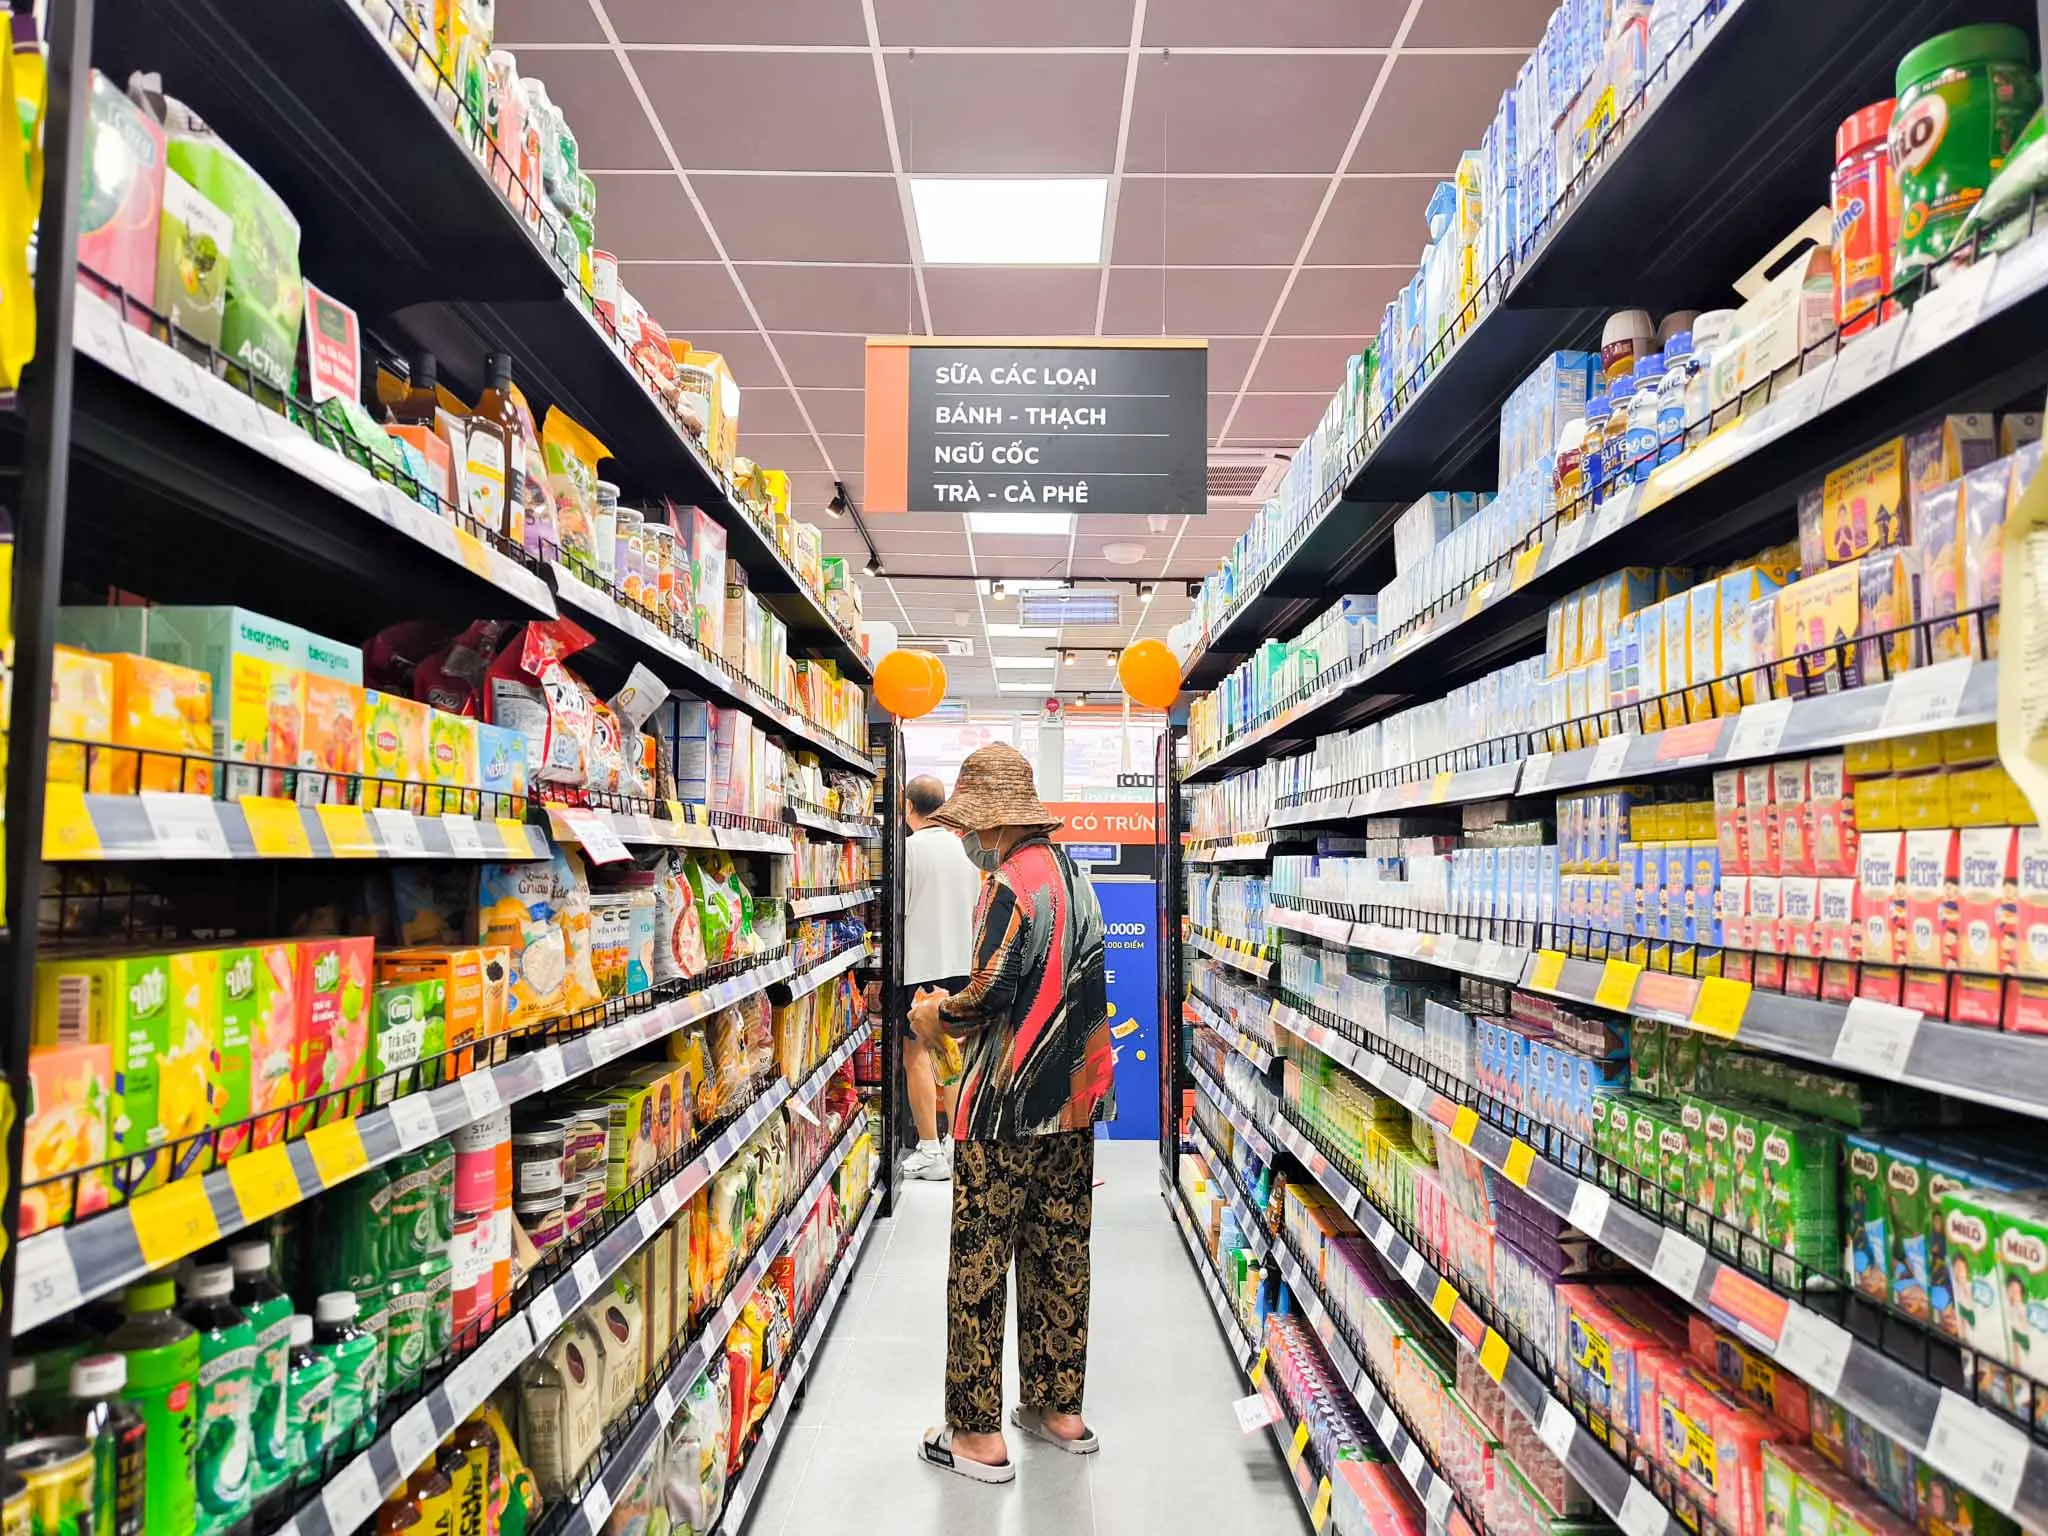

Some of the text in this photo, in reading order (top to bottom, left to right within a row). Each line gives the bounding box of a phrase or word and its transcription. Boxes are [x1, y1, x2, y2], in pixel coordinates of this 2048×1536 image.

[935, 362, 1097, 390] SỮA CÁC LOẠI
[935, 401, 1002, 424] BÁNH
[1025, 407, 1106, 430] THẠCH
[934, 439, 1039, 464] NGŨ CỐC
[933, 479, 981, 502] TRÀ
[1004, 479, 1036, 503] CÀ
[1042, 480, 1089, 503] PHÊ
[1071, 812, 1098, 831] CÓ
[1103, 811, 1158, 831] TRỨN
[1863, 857, 1891, 871] Grow
[1908, 857, 1939, 871] Grow
[1963, 856, 1998, 871] Grow
[1661, 1134, 1681, 1150] MILO
[1766, 1142, 1787, 1159] MILO
[1854, 1155, 1875, 1173] MILO
[1892, 1168, 1916, 1187] MILO
[1951, 1219, 1981, 1242] MILO
[2007, 1238, 2041, 1263] MILO
